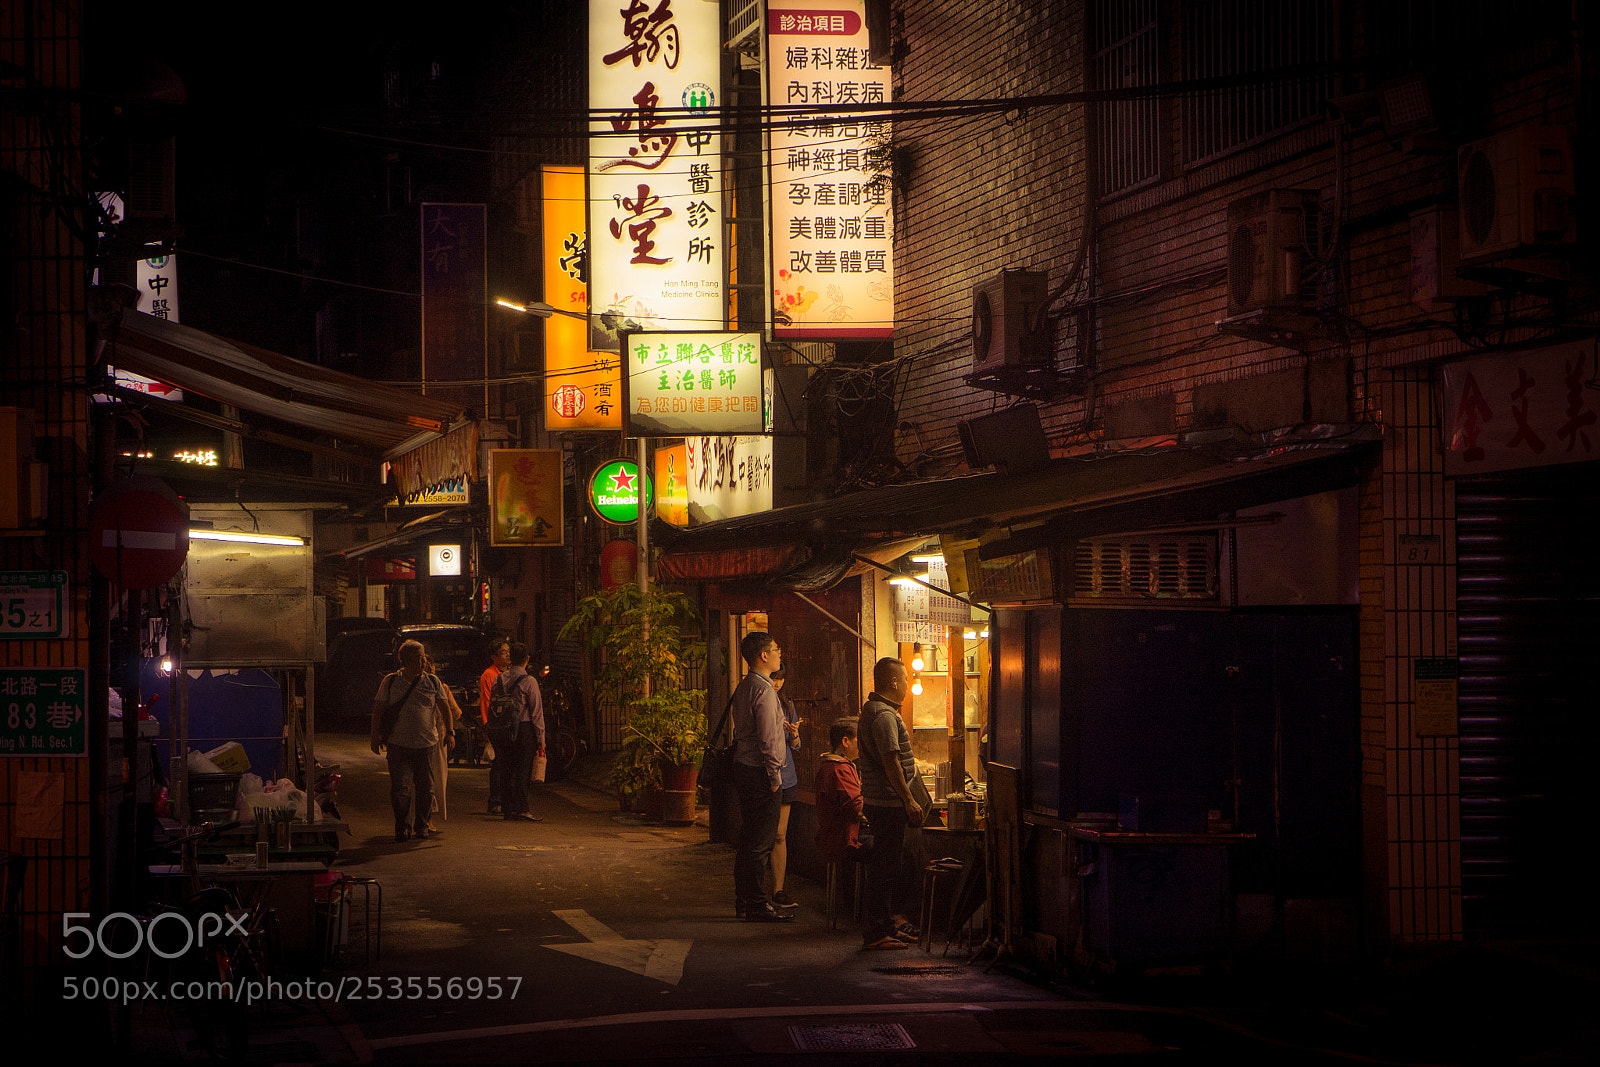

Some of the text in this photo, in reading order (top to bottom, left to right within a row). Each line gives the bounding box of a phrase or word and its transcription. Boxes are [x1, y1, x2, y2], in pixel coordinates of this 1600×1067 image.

[780, 14, 845, 32] 診治項目
[786, 80, 884, 104] 內科疾病
[685, 130, 717, 265] 中醫診所
[788, 182, 886, 206] 孕產調理
[789, 216, 887, 240] 美體減重
[789, 250, 888, 274] 改善體質
[661, 290, 720, 299] Medicine Clinics
[664, 280, 719, 289] Han Ming Tang
[633, 343, 758, 365] 市立聯合醫院
[657, 369, 737, 391] 主治醫師
[636, 396, 758, 414] 為您的健康把關
[1408, 547, 1429, 561] 81
[1, 676, 78, 696] 北路一段
[32, 735, 46, 749] Rd.
